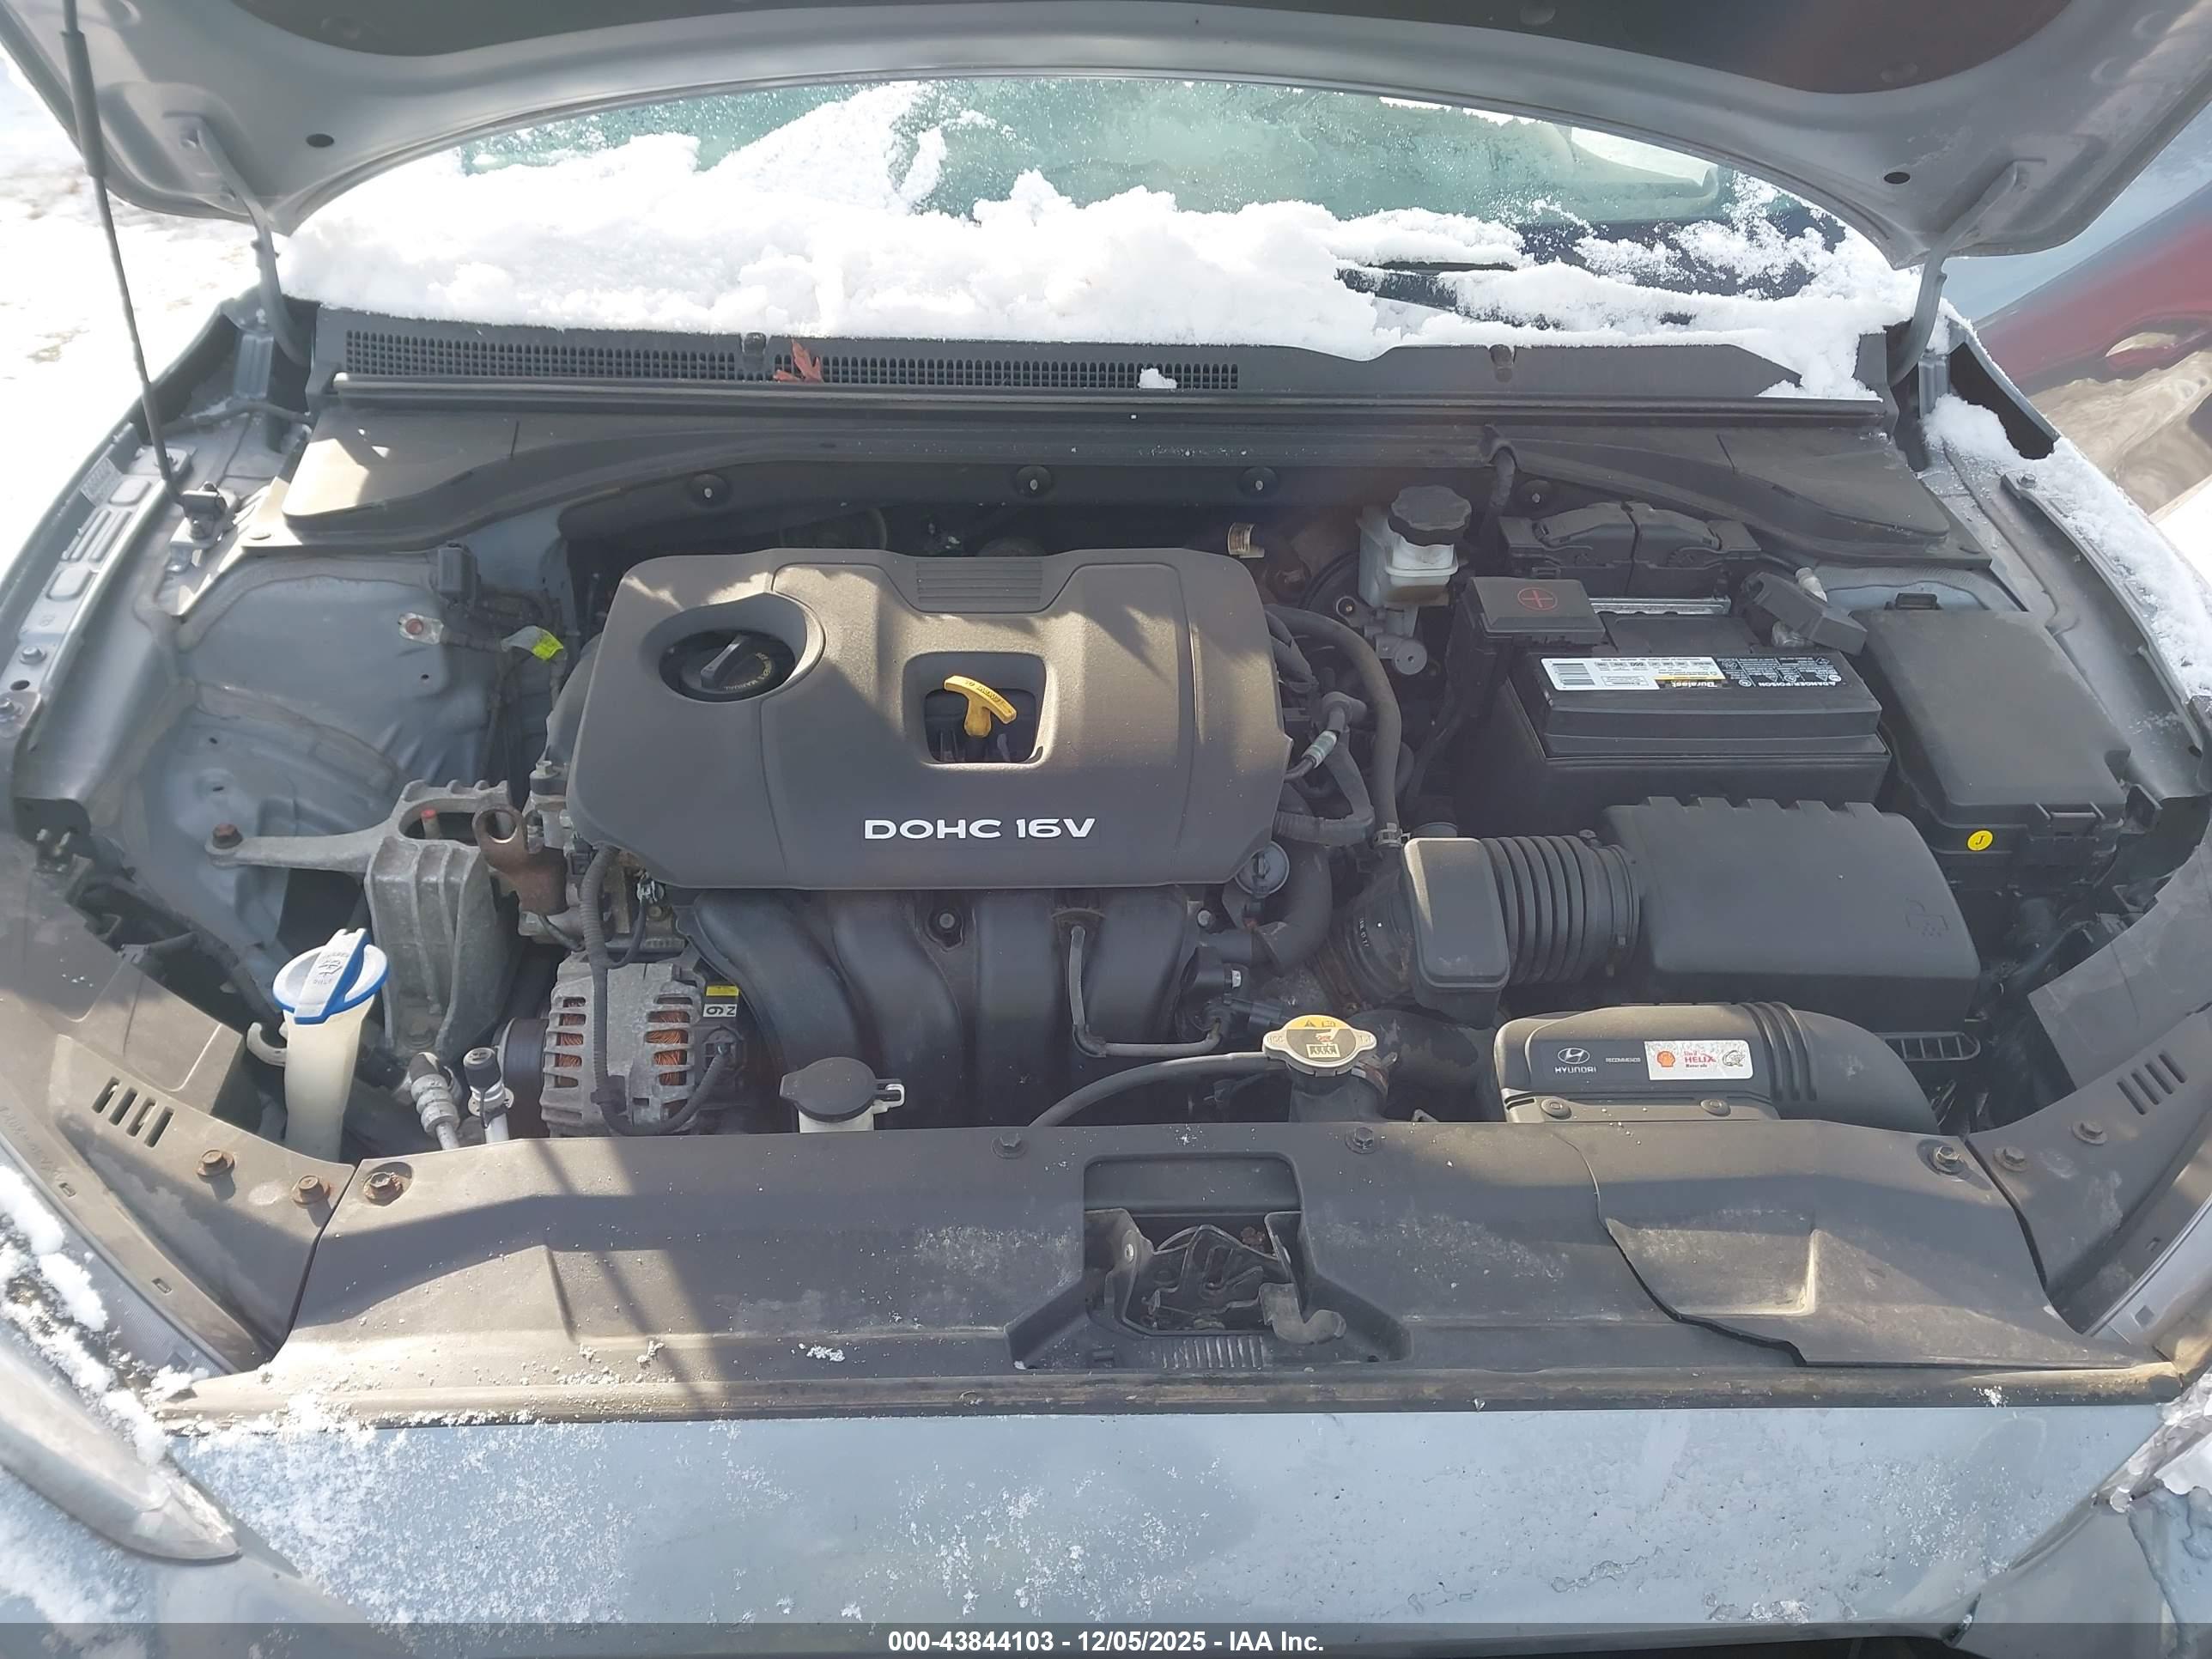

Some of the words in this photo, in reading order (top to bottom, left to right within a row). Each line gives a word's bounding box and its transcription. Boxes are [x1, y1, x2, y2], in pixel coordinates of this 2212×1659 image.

[1670, 680, 1717, 689] Duralast
[864, 819, 1002, 839] DOHC
[1016, 817, 1096, 838] 16V
[1975, 835, 1985, 845] J
[1684, 1055, 1717, 1064] HELIX
